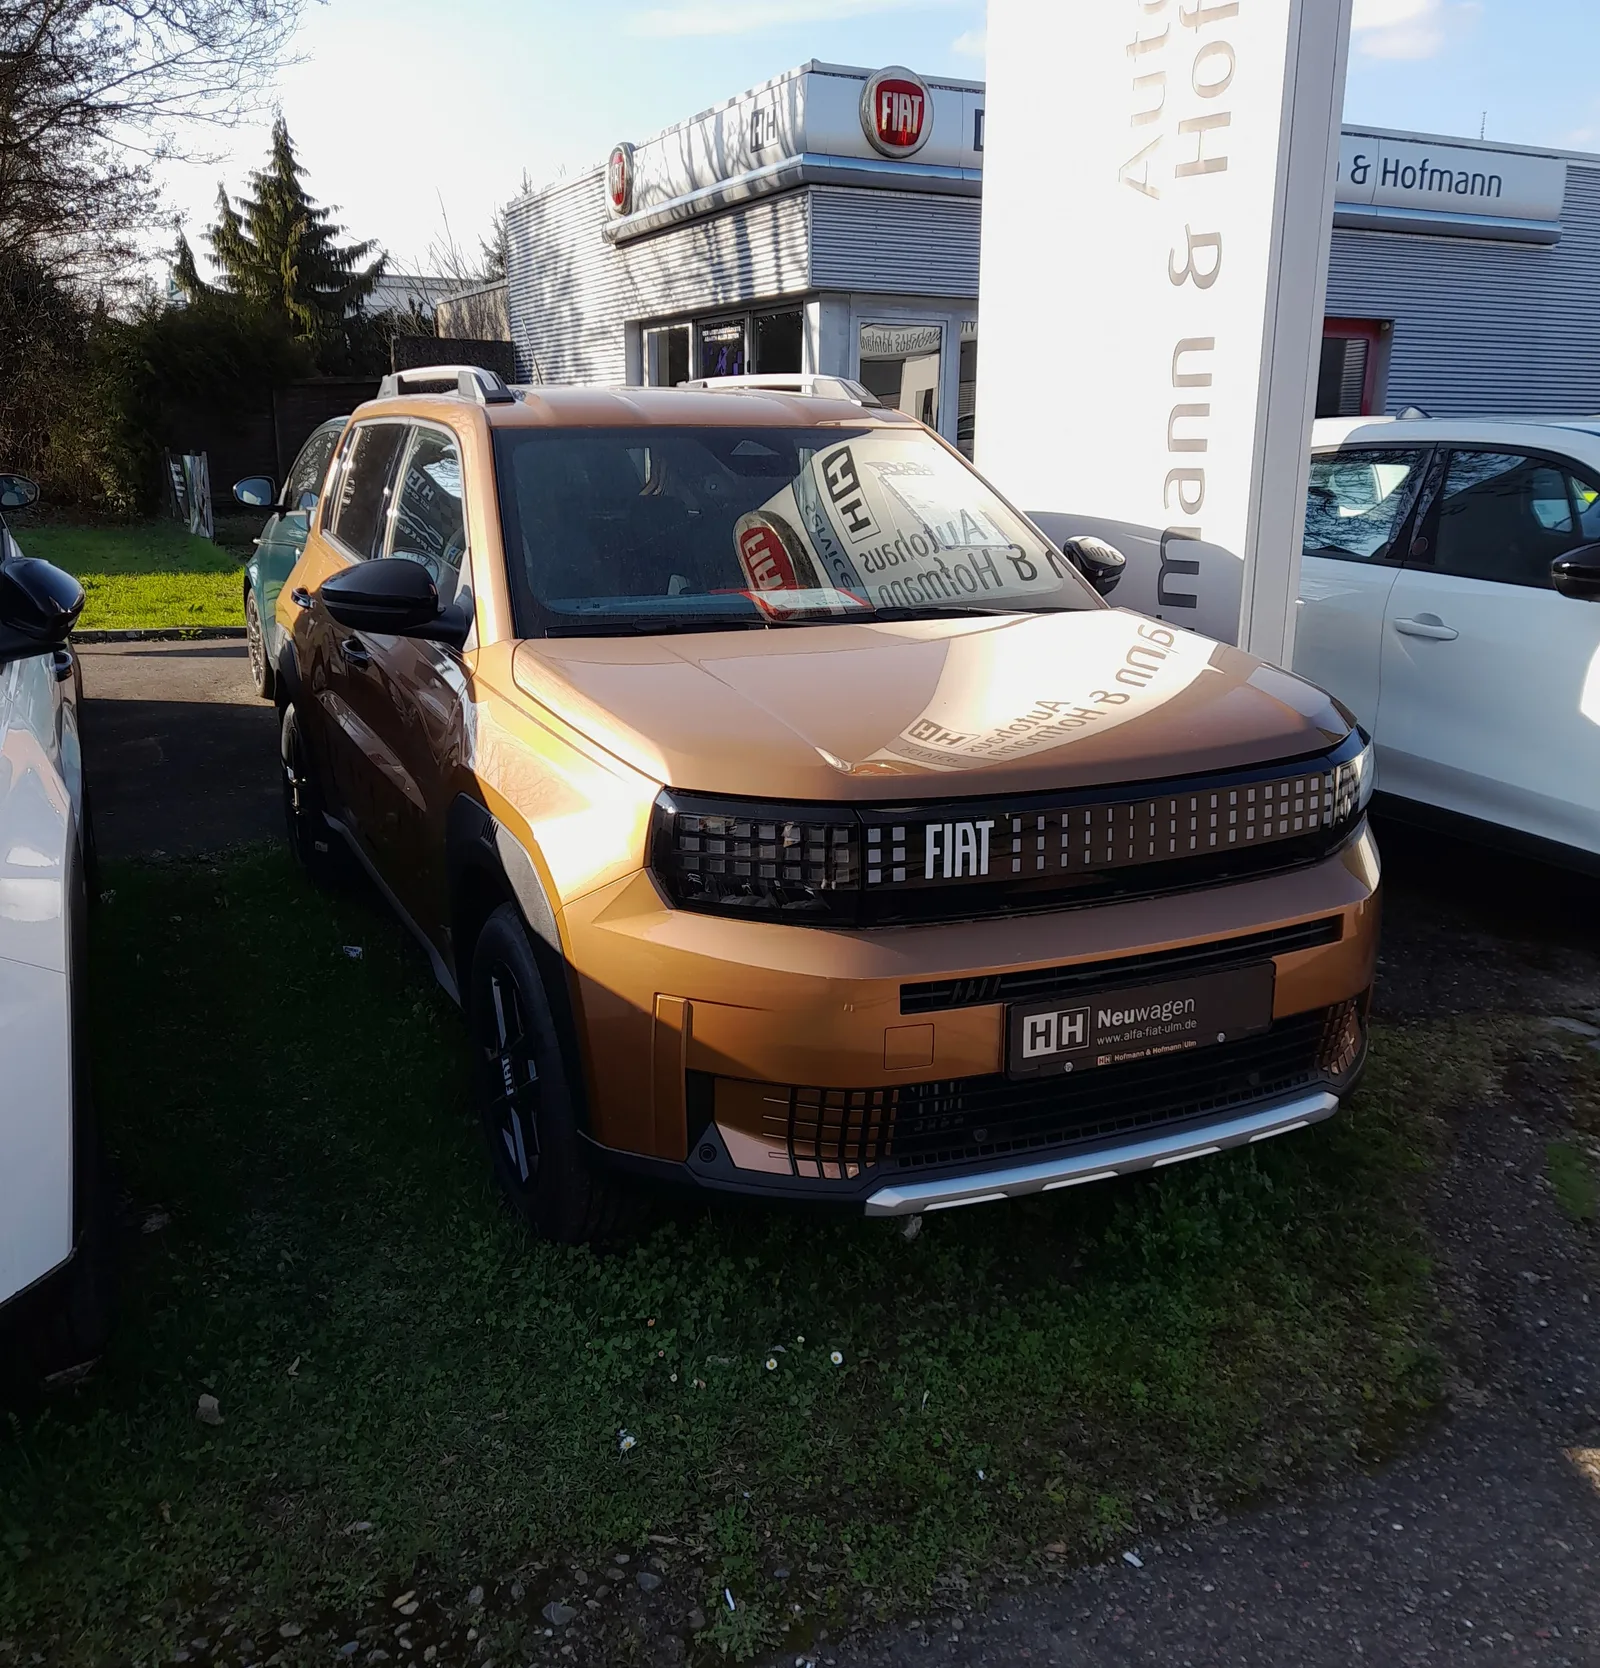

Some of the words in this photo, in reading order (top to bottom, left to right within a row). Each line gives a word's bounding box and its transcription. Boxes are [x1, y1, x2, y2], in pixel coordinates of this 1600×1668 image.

[881, 91, 922, 134] FIAT
[1350, 154, 1372, 185] &
[1381, 157, 1503, 198] Hofmann
[1167, 222, 1223, 290] &
[1156, 336, 1216, 632] mann
[924, 820, 995, 879] FIAT
[1096, 1019, 1198, 1045] www.alfa-fiat-ulm.de
[1097, 998, 1195, 1029] Neuwagen
[1114, 1051, 1145, 1062] Hofmann
[1145, 1048, 1152, 1056] &
[1152, 1043, 1182, 1054] Hofmann
[502, 1058, 515, 1096] FIAT
